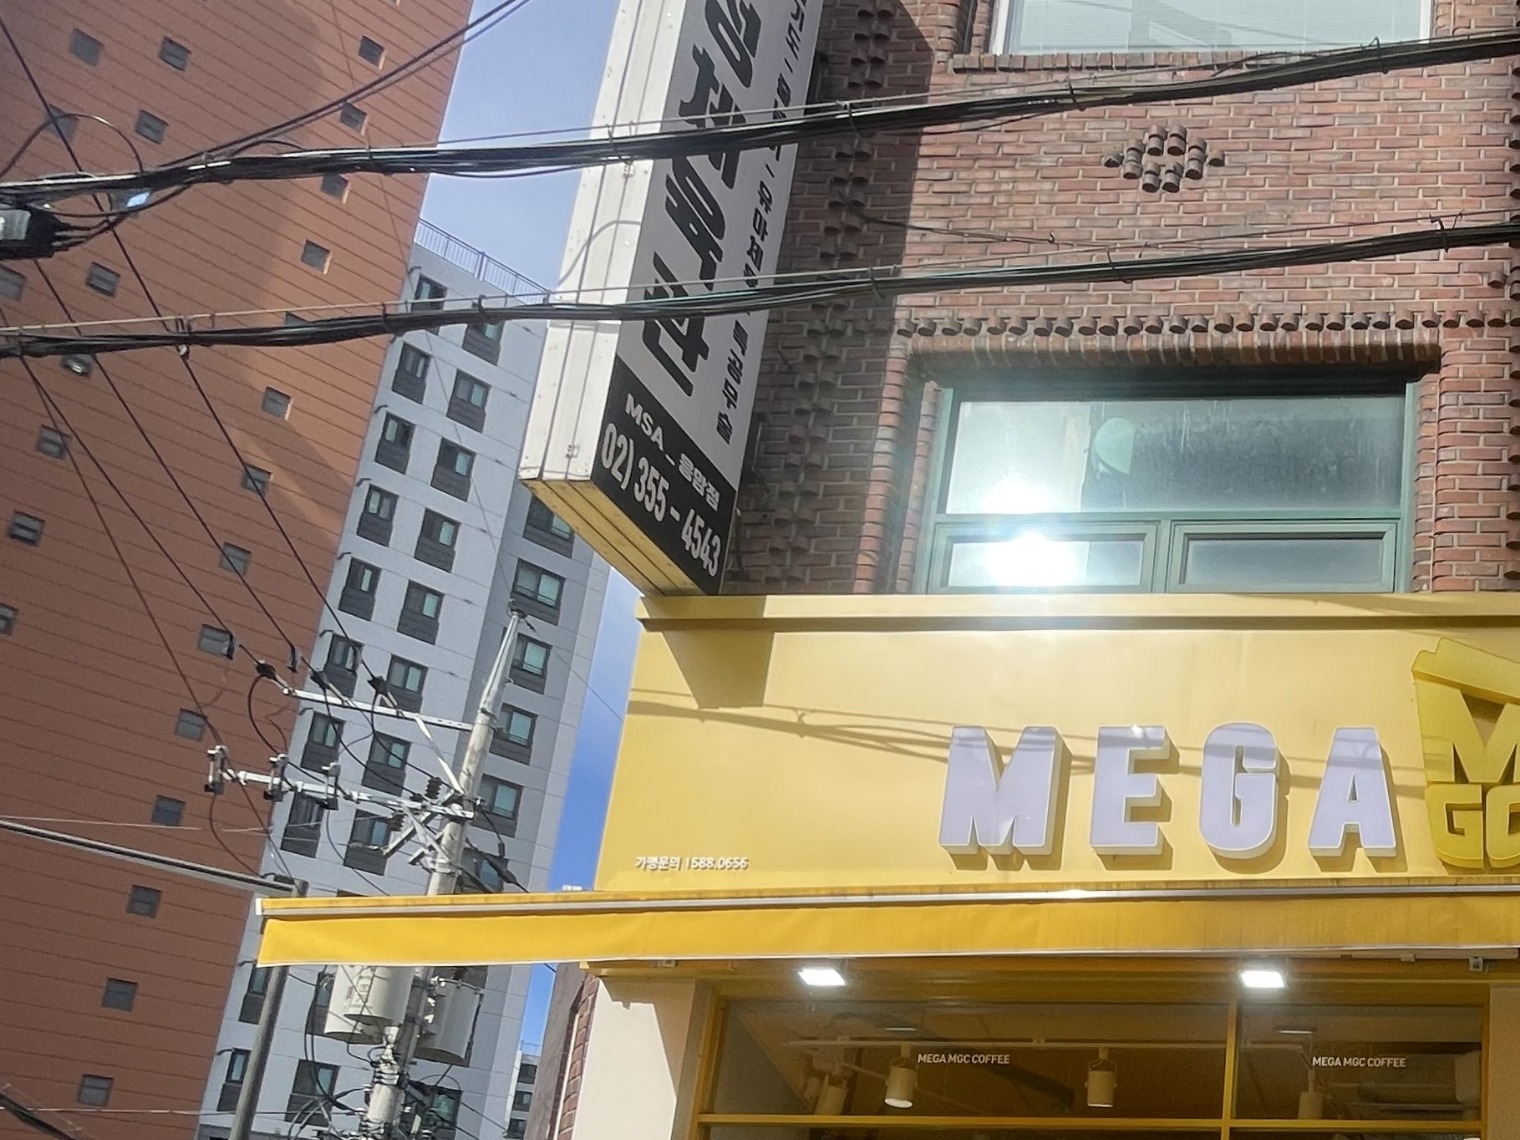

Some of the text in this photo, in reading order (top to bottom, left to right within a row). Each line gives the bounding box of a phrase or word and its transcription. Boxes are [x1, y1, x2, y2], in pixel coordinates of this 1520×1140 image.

[716, 319, 749, 445] 특공무술
[601, 423, 634, 490] 02)
[633, 457, 670, 522] 355
[681, 509, 722, 577] 4543
[625, 393, 664, 451] MSA
[678, 453, 720, 512] 응암점
[938, 722, 1399, 858] MEGA
[635, 856, 682, 871] 가맹문의
[918, 1053, 1010, 1064] MEGA MGC COFFEE
[1312, 1056, 1407, 1067] MEGA MGC COFFEE
